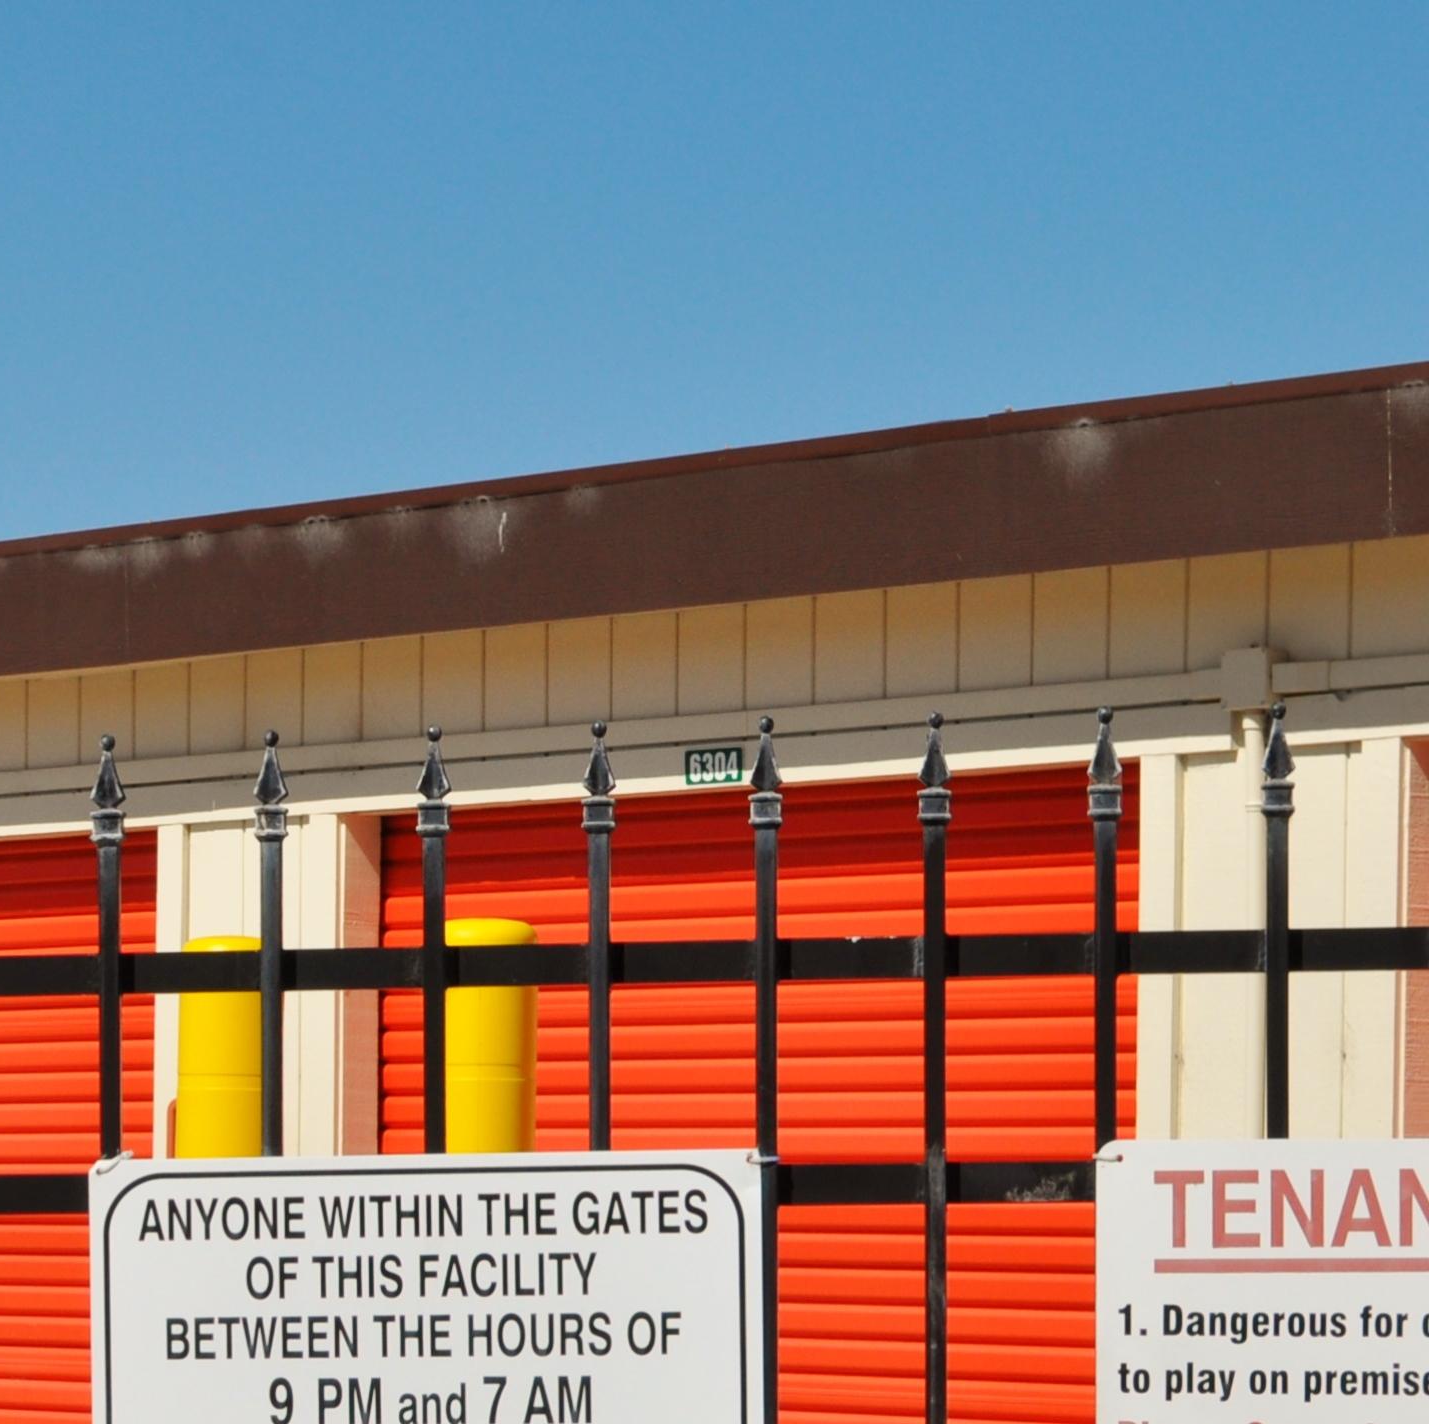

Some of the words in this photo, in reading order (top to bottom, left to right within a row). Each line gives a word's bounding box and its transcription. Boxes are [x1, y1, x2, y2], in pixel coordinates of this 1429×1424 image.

[689, 751, 739, 782] 6304
[139, 1197, 305, 1241] ANYONE
[319, 1194, 462, 1238] WITHIN
[478, 1193, 557, 1236] THE
[573, 1189, 707, 1235] GATES
[247, 1257, 298, 1300] OF
[312, 1255, 403, 1298] THIS
[420, 1253, 596, 1297] FACILITY
[167, 1316, 358, 1359] BETWEEN
[373, 1315, 451, 1357] THE
[468, 1312, 611, 1357] HOURS
[628, 1312, 681, 1355] OF
[1119, 1304, 1147, 1336] 1.
[1163, 1305, 1346, 1344] Dangerous
[1360, 1306, 1407, 1337] for
[483, 1377, 506, 1424] 7
[524, 1376, 591, 1424] AM
[1118, 1363, 1150, 1393] to
[1166, 1362, 1235, 1401] play
[1250, 1370, 1288, 1394] on
